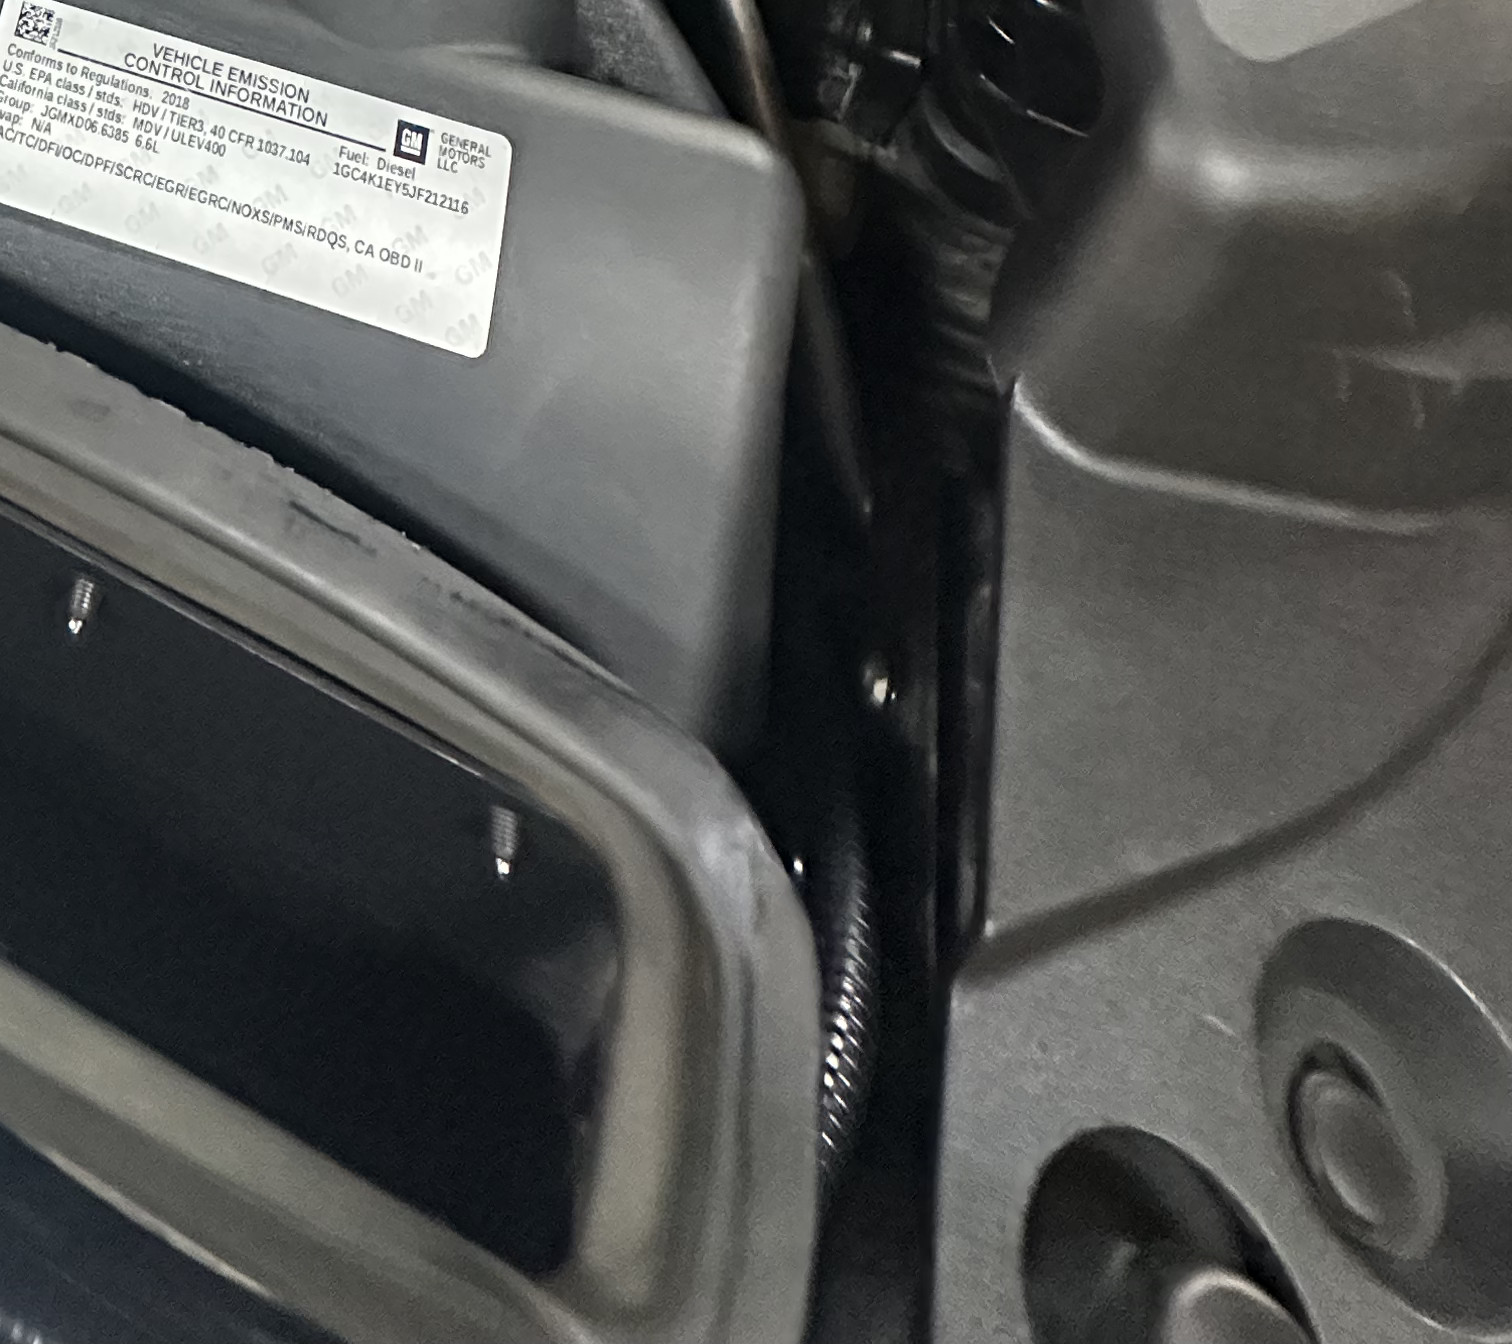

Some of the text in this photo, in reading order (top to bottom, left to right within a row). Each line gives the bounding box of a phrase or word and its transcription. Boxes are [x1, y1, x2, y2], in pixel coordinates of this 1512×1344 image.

[7, 43, 63, 71] Conforms
[65, 62, 78, 76] to
[161, 90, 190, 111] 2018
[124, 52, 328, 127] CONTROL INFORMATION
[153, 42, 310, 104] VEHICLE EMISSION
[2, 59, 24, 76] U.S.
[28, 67, 52, 85] EPA
[55, 77, 86, 96] class
[86, 85, 94, 99] /
[132, 99, 160, 118] HDV
[160, 108, 168, 121] /
[170, 110, 207, 136] TIER3,
[209, 124, 226, 140] 40
[228, 129, 255, 150] CFR
[256, 138, 311, 167] 1037.104
[30, 117, 52, 135] N/A
[40, 105, 129, 144] JGMXD06.6385
[134, 134, 159, 154] 6.6L
[56, 94, 87, 113] class
[88, 102, 95, 115] /
[132, 116, 163, 137] MDV
[162, 126, 170, 140] /
[170, 128, 227, 158] ULEV400
[376, 156, 416, 181] Diesel
[436, 157, 458, 174] LLC
[438, 145, 486, 170] MOTORS
[440, 132, 491, 158] GENERAL
[332, 162, 469, 215] 1GC4K1EY5JF212116
[354, 239, 375, 259] CA
[378, 247, 411, 269] OBD
